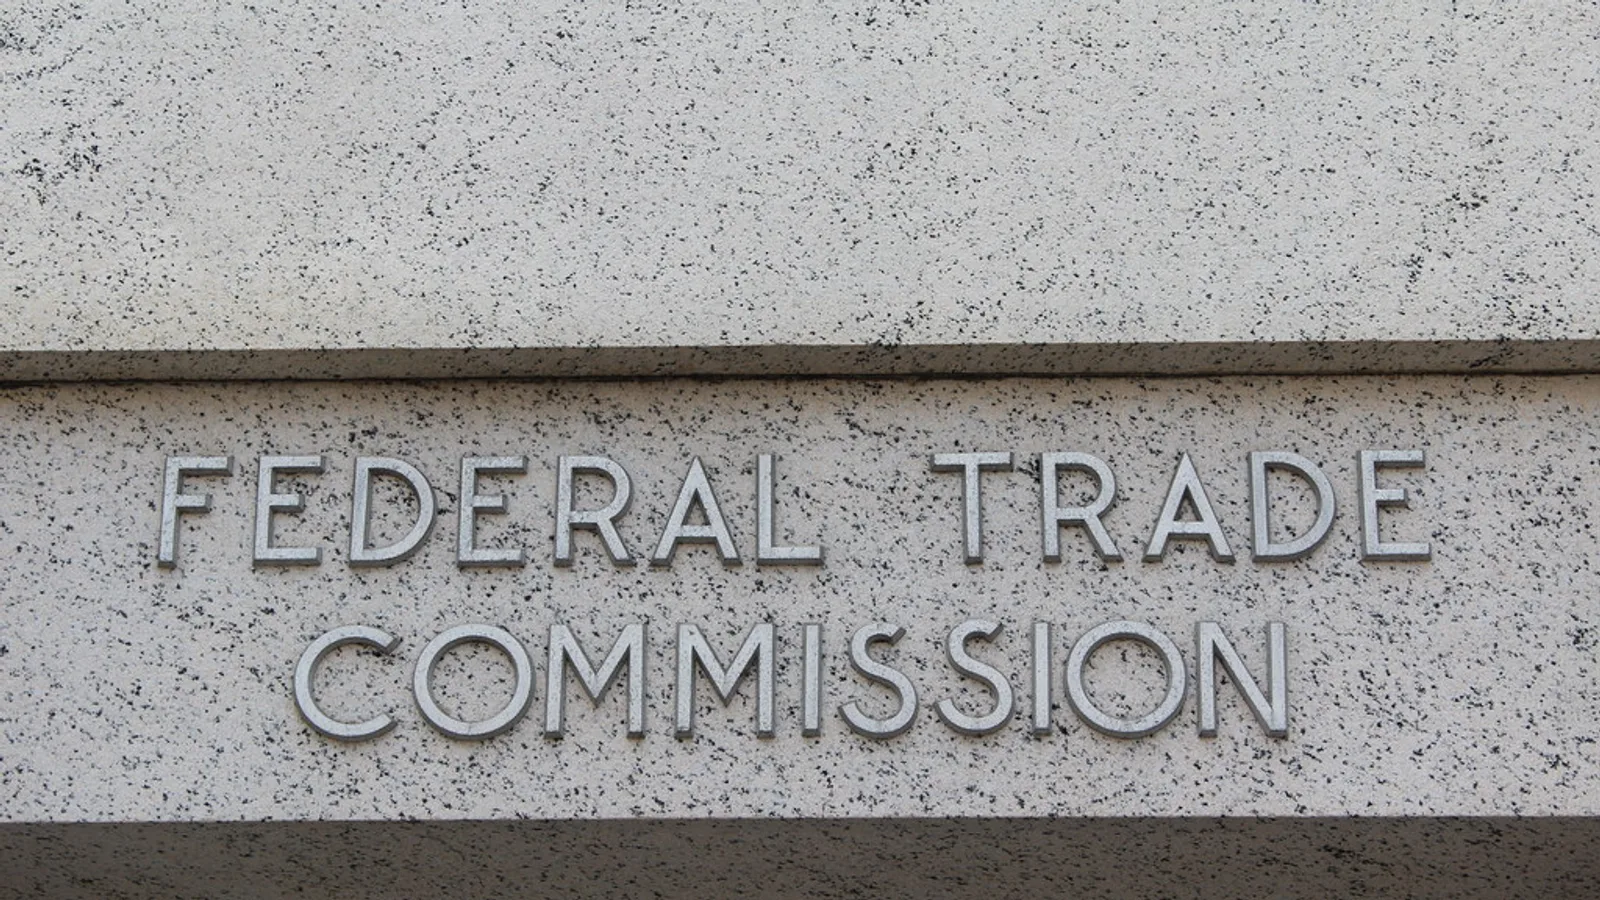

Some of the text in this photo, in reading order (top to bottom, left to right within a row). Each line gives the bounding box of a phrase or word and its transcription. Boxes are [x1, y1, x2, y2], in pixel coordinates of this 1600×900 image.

[156, 449, 1433, 568] FEDERAL TRADE
[293, 620, 1290, 739] COMMISSION
